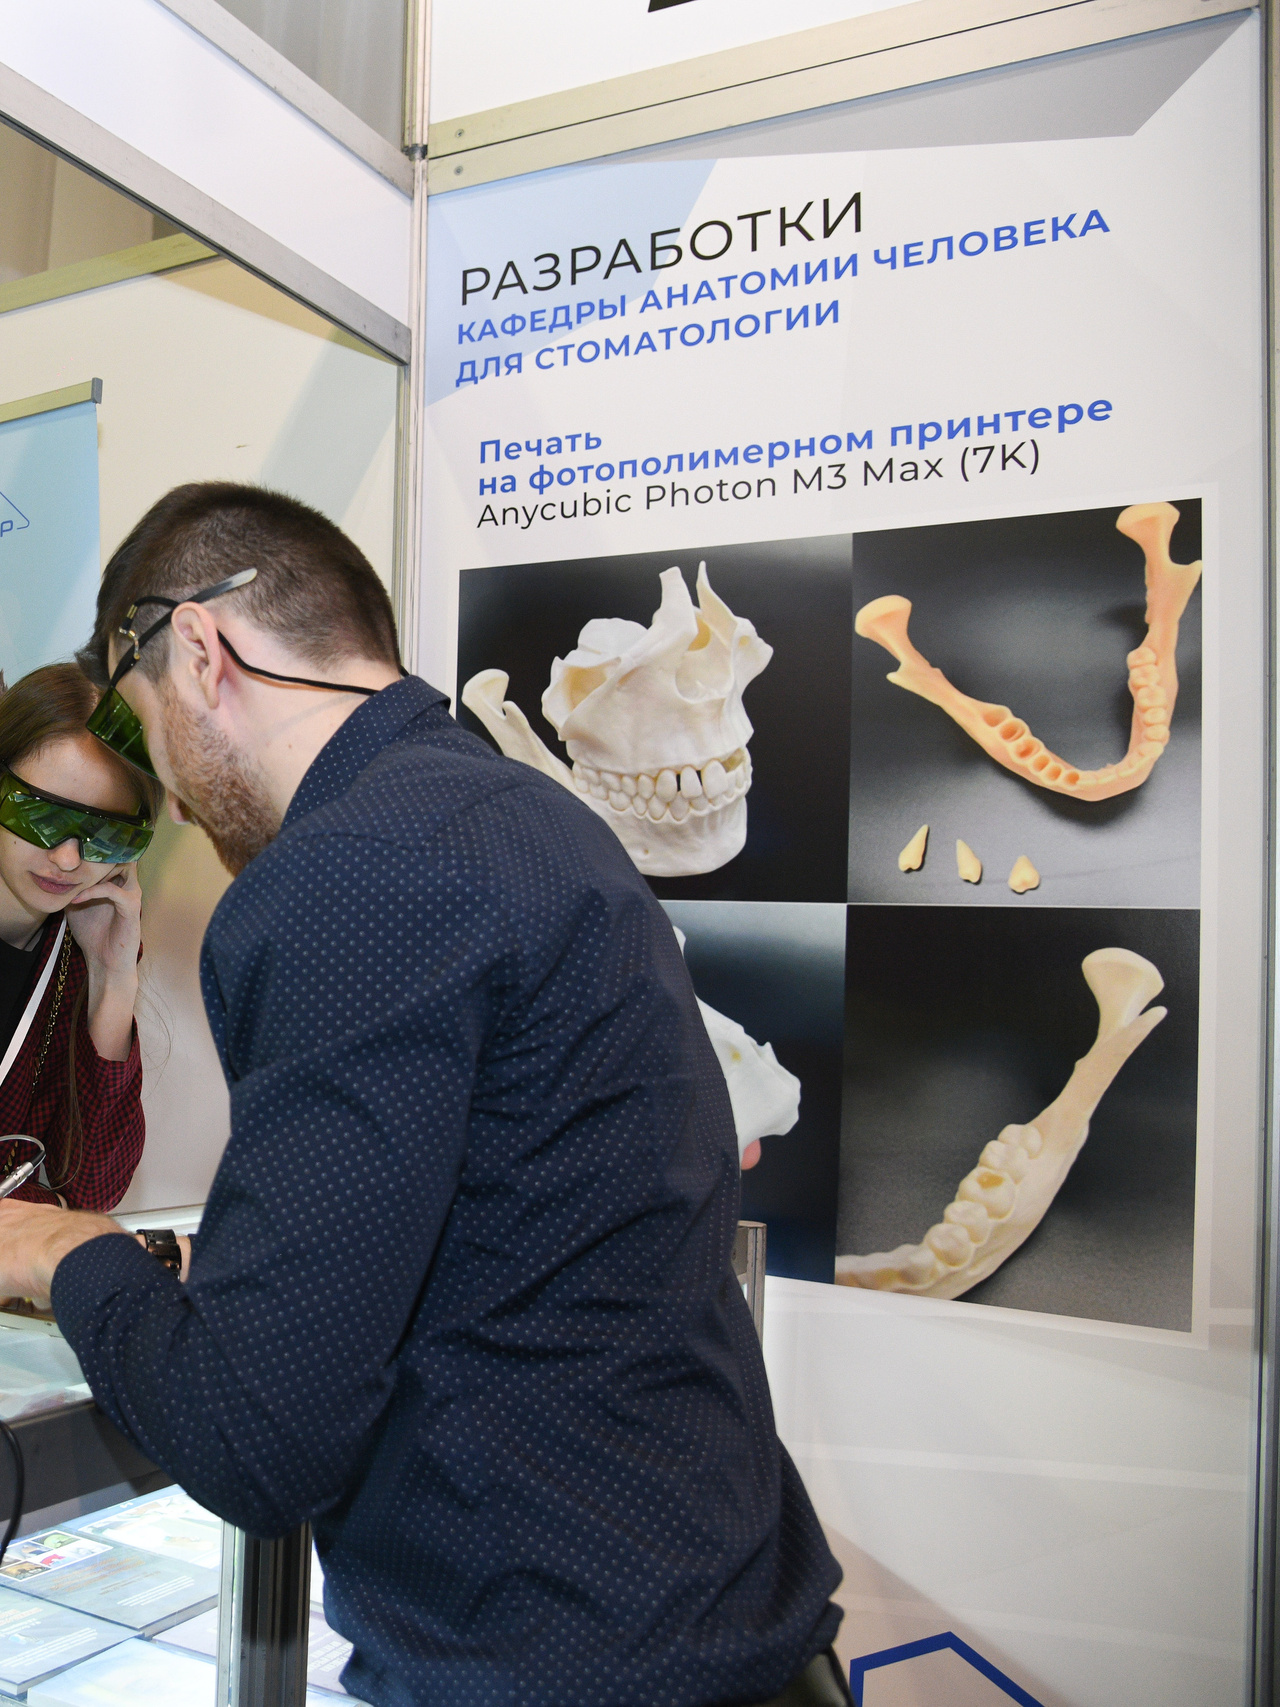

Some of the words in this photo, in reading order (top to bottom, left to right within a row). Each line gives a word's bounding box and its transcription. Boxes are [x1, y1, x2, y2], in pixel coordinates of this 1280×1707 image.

[457, 294, 627, 345] КАФЕДРЫ
[639, 252, 859, 315] АНАТОМИИ
[873, 208, 1111, 271] ЧЕЛОВЕКА
[461, 191, 862, 306] РАЗРАБОТКИ
[455, 351, 523, 388] ДЛЯ
[535, 299, 840, 371] СТОМАТОЛОГИИ
[476, 500, 633, 530] Anycubic
[645, 480, 778, 511] Photon
[793, 463, 847, 494] M3
[863, 453, 944, 487] Max
[960, 437, 1041, 483] (7K)
[477, 475, 520, 497] на
[528, 430, 874, 497] фотополимерном
[890, 396, 1113, 452] принтере
[479, 430, 602, 465] Печать
